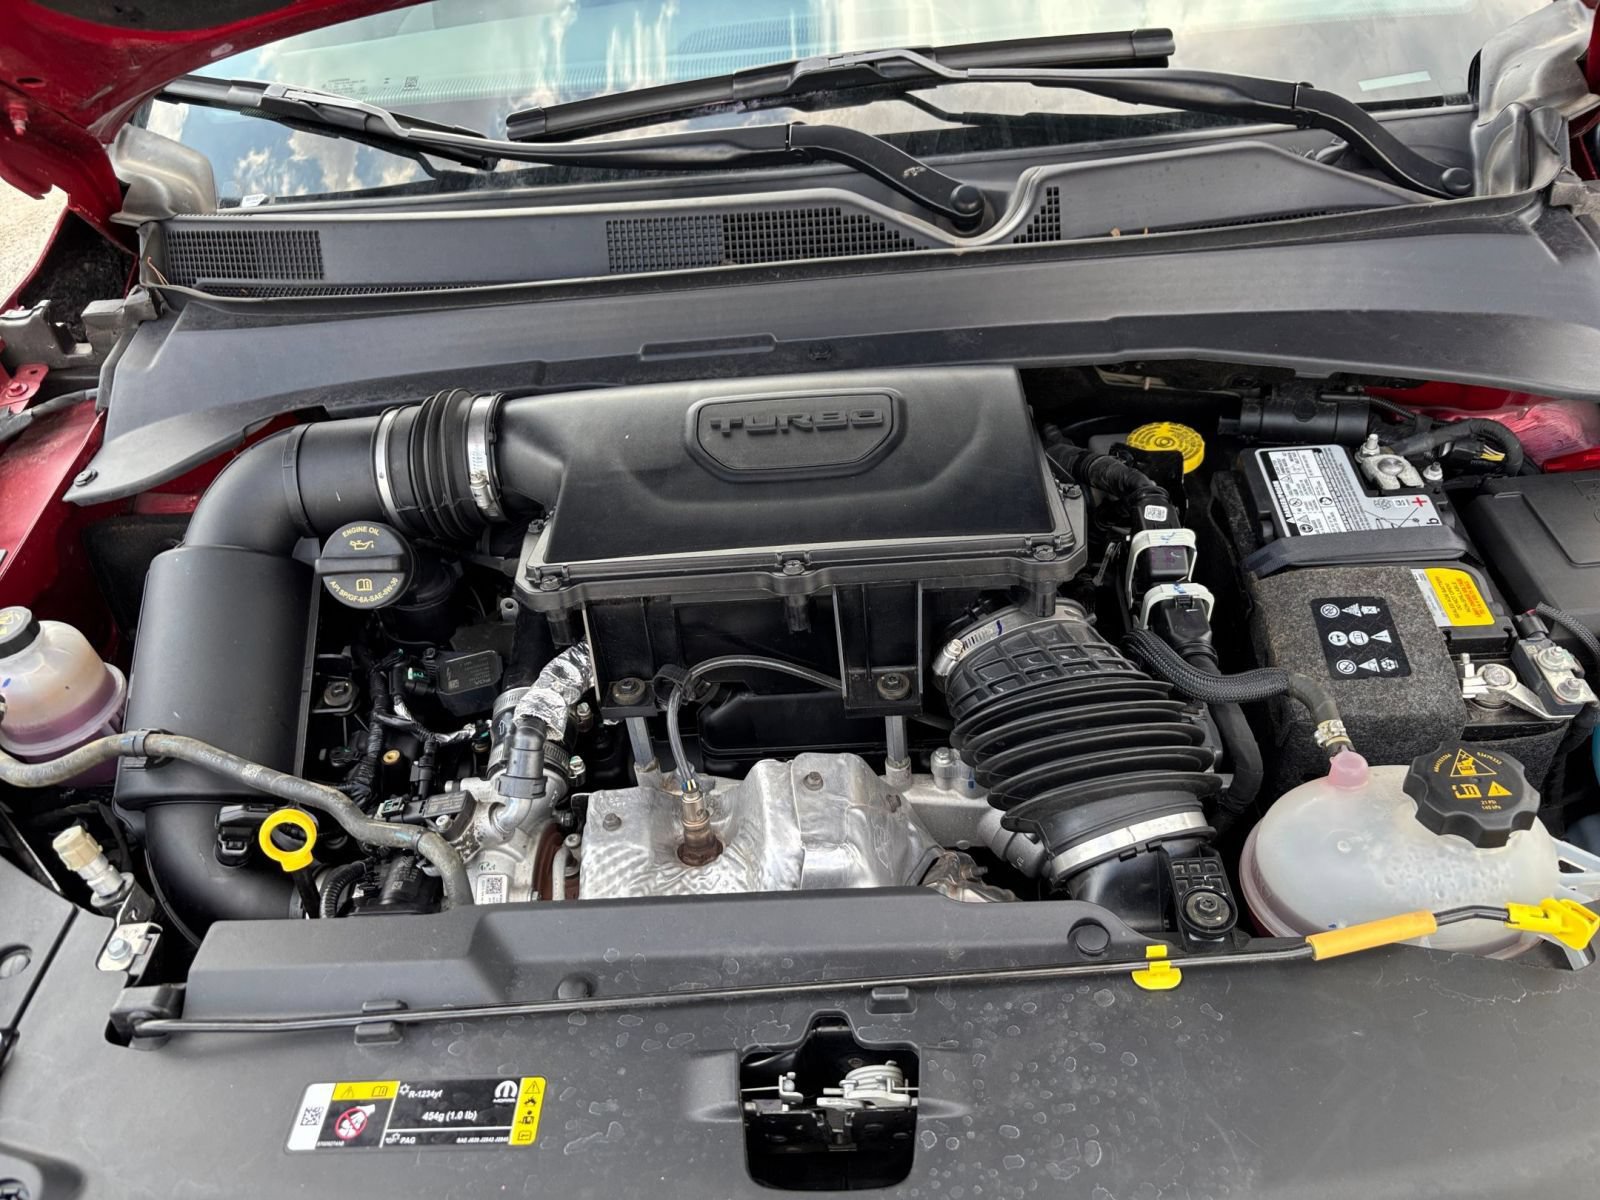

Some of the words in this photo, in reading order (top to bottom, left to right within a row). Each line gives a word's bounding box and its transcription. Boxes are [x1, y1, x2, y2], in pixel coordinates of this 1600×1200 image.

[710, 409, 883, 437] TURBO
[342, 526, 368, 538] ENGINE
[368, 527, 379, 536] OIL
[330, 581, 341, 592] API
[408, 1090, 443, 1099] R-1234yf
[422, 1111, 444, 1122] 454g
[446, 1111, 463, 1121] (1.0
[464, 1110, 477, 1121] lb)
[400, 1136, 416, 1144] PAG
